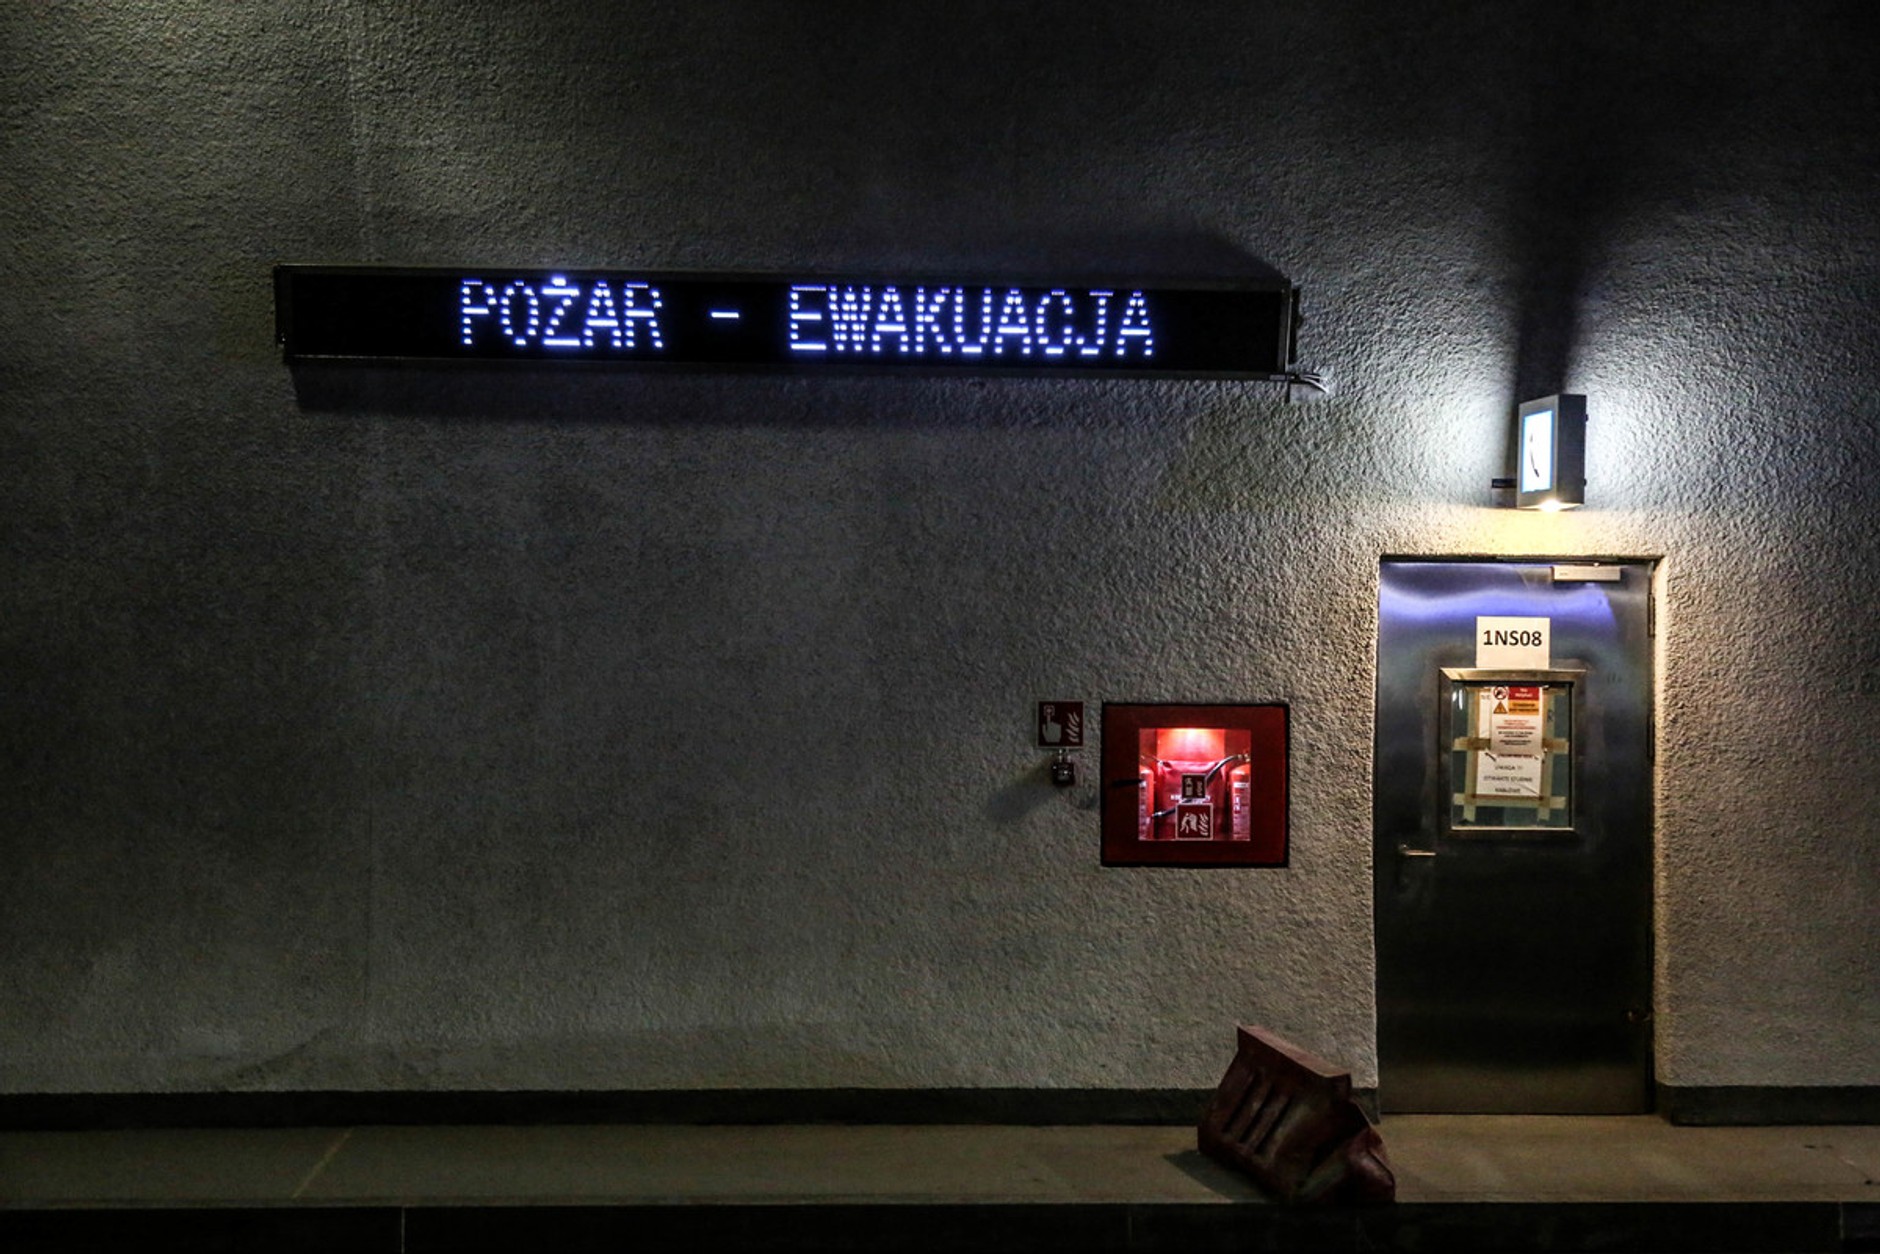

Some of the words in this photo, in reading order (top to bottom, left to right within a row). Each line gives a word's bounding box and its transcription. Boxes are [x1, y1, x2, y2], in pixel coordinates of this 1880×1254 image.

[462, 277, 664, 348] POŻAR
[790, 286, 1153, 357] EWAKUACJA
[1483, 630, 1543, 647] 1NS08
